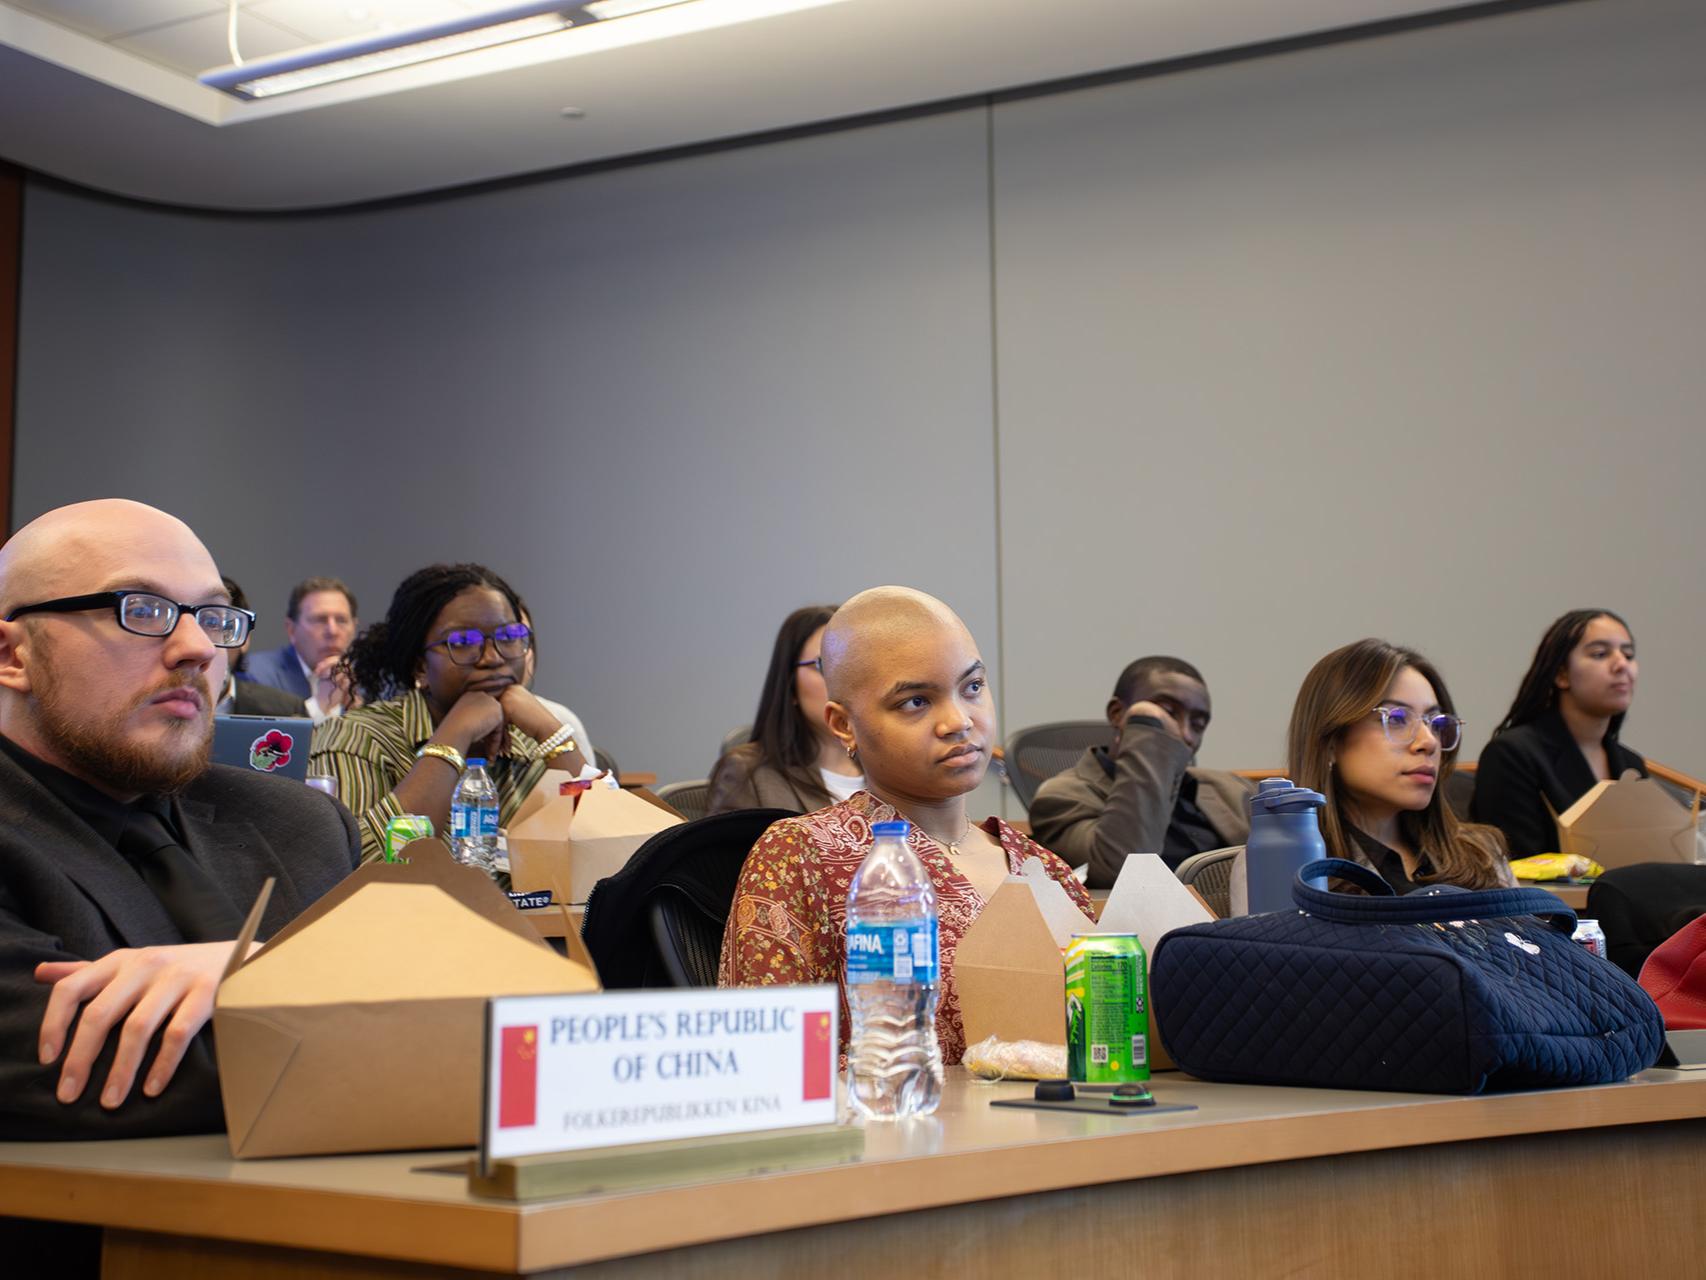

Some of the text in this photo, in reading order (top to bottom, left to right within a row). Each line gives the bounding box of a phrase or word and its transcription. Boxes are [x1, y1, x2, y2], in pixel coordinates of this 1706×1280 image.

[512, 897, 543, 907] TATE
[551, 1005, 795, 1043] PEOPLE'S REPUBLIC
[612, 1049, 738, 1082] OF CHINA
